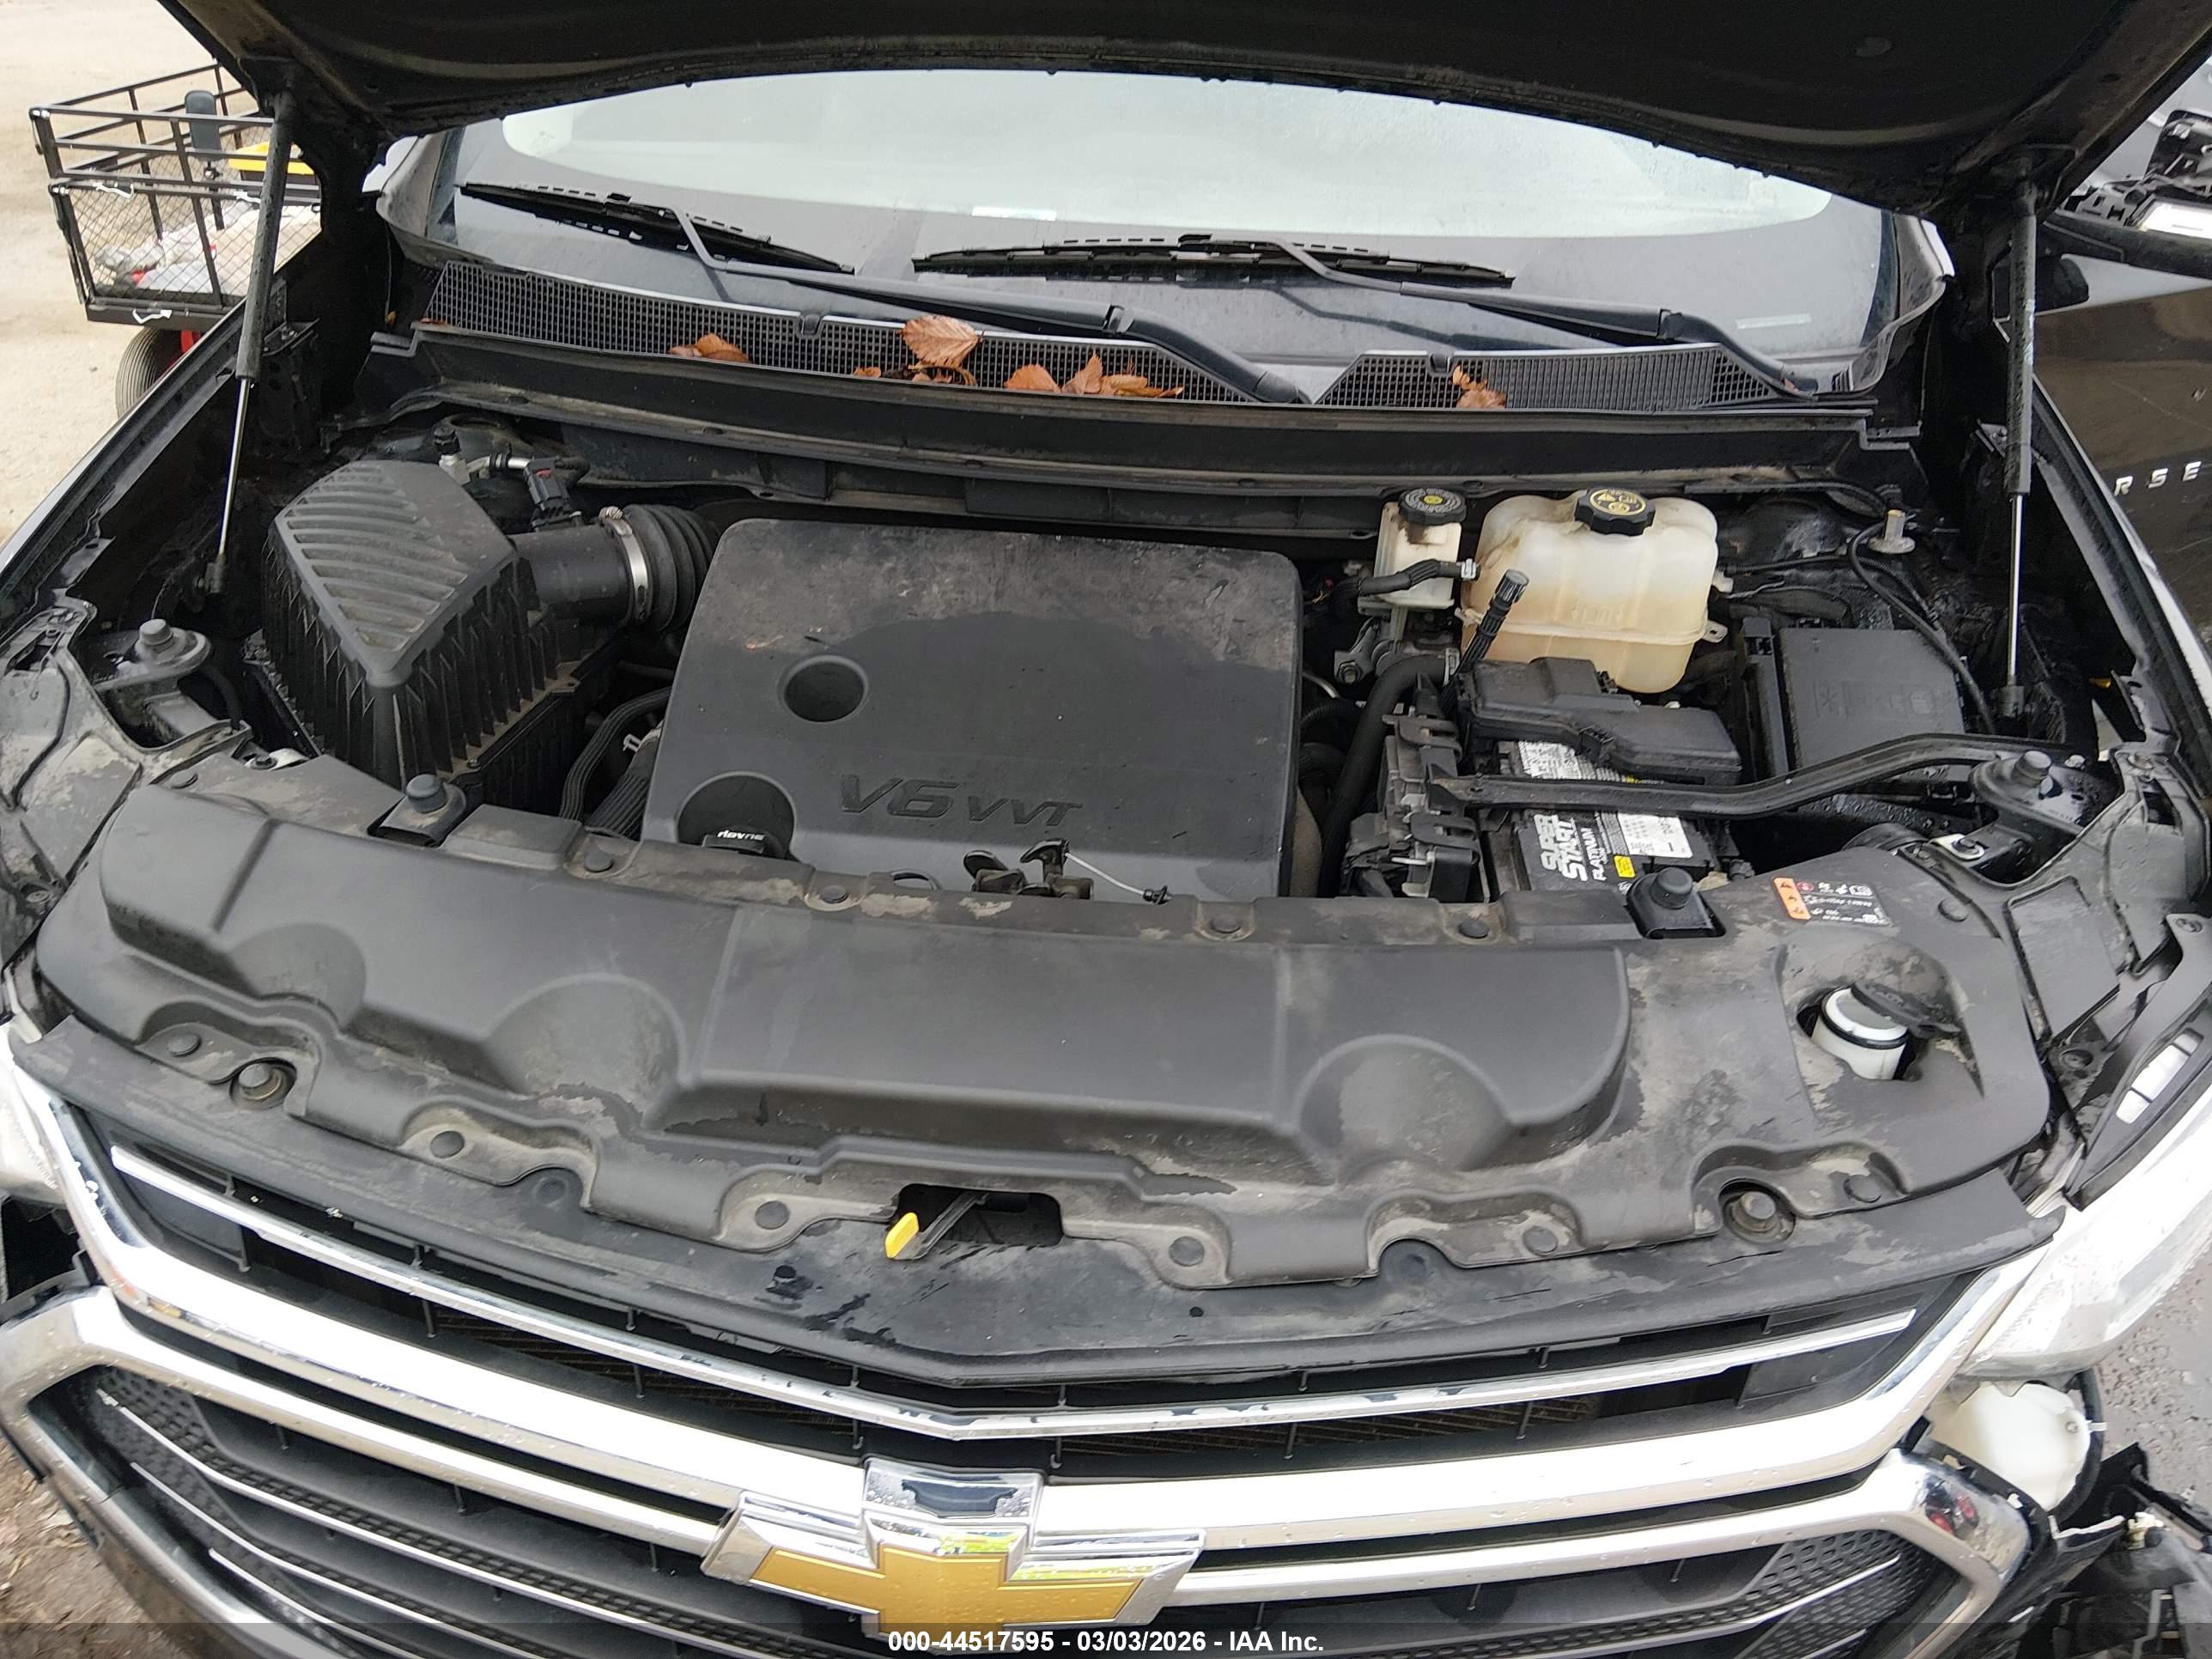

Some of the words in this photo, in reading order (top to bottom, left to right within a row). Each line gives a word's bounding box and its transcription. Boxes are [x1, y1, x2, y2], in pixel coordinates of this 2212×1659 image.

[841, 775, 959, 818] V6
[968, 795, 1083, 826] VVT
[1534, 814, 1559, 870] SUPER
[1556, 817, 1588, 881] START
